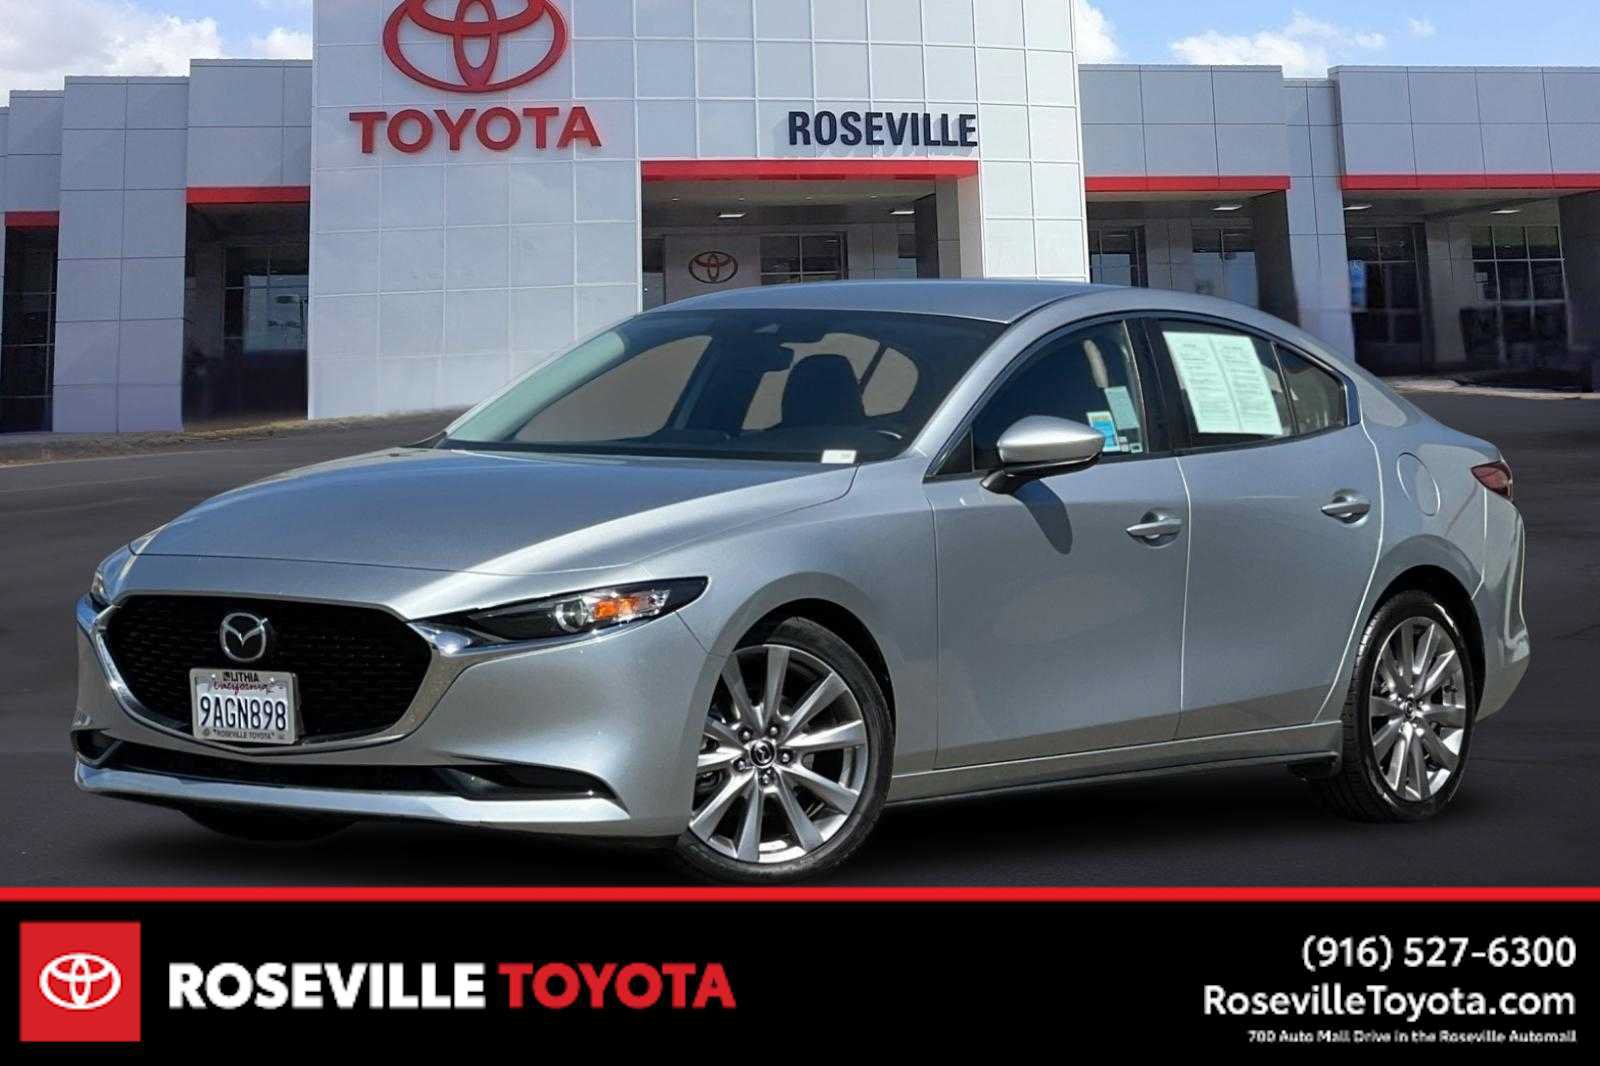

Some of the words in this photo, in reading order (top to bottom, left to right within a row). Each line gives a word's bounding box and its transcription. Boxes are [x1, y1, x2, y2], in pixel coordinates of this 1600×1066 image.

[350, 106, 602, 153] TOYOTA
[788, 111, 978, 147] ROSEVILLE
[231, 672, 259, 682] LITHIA
[201, 696, 286, 731] 9AGN898
